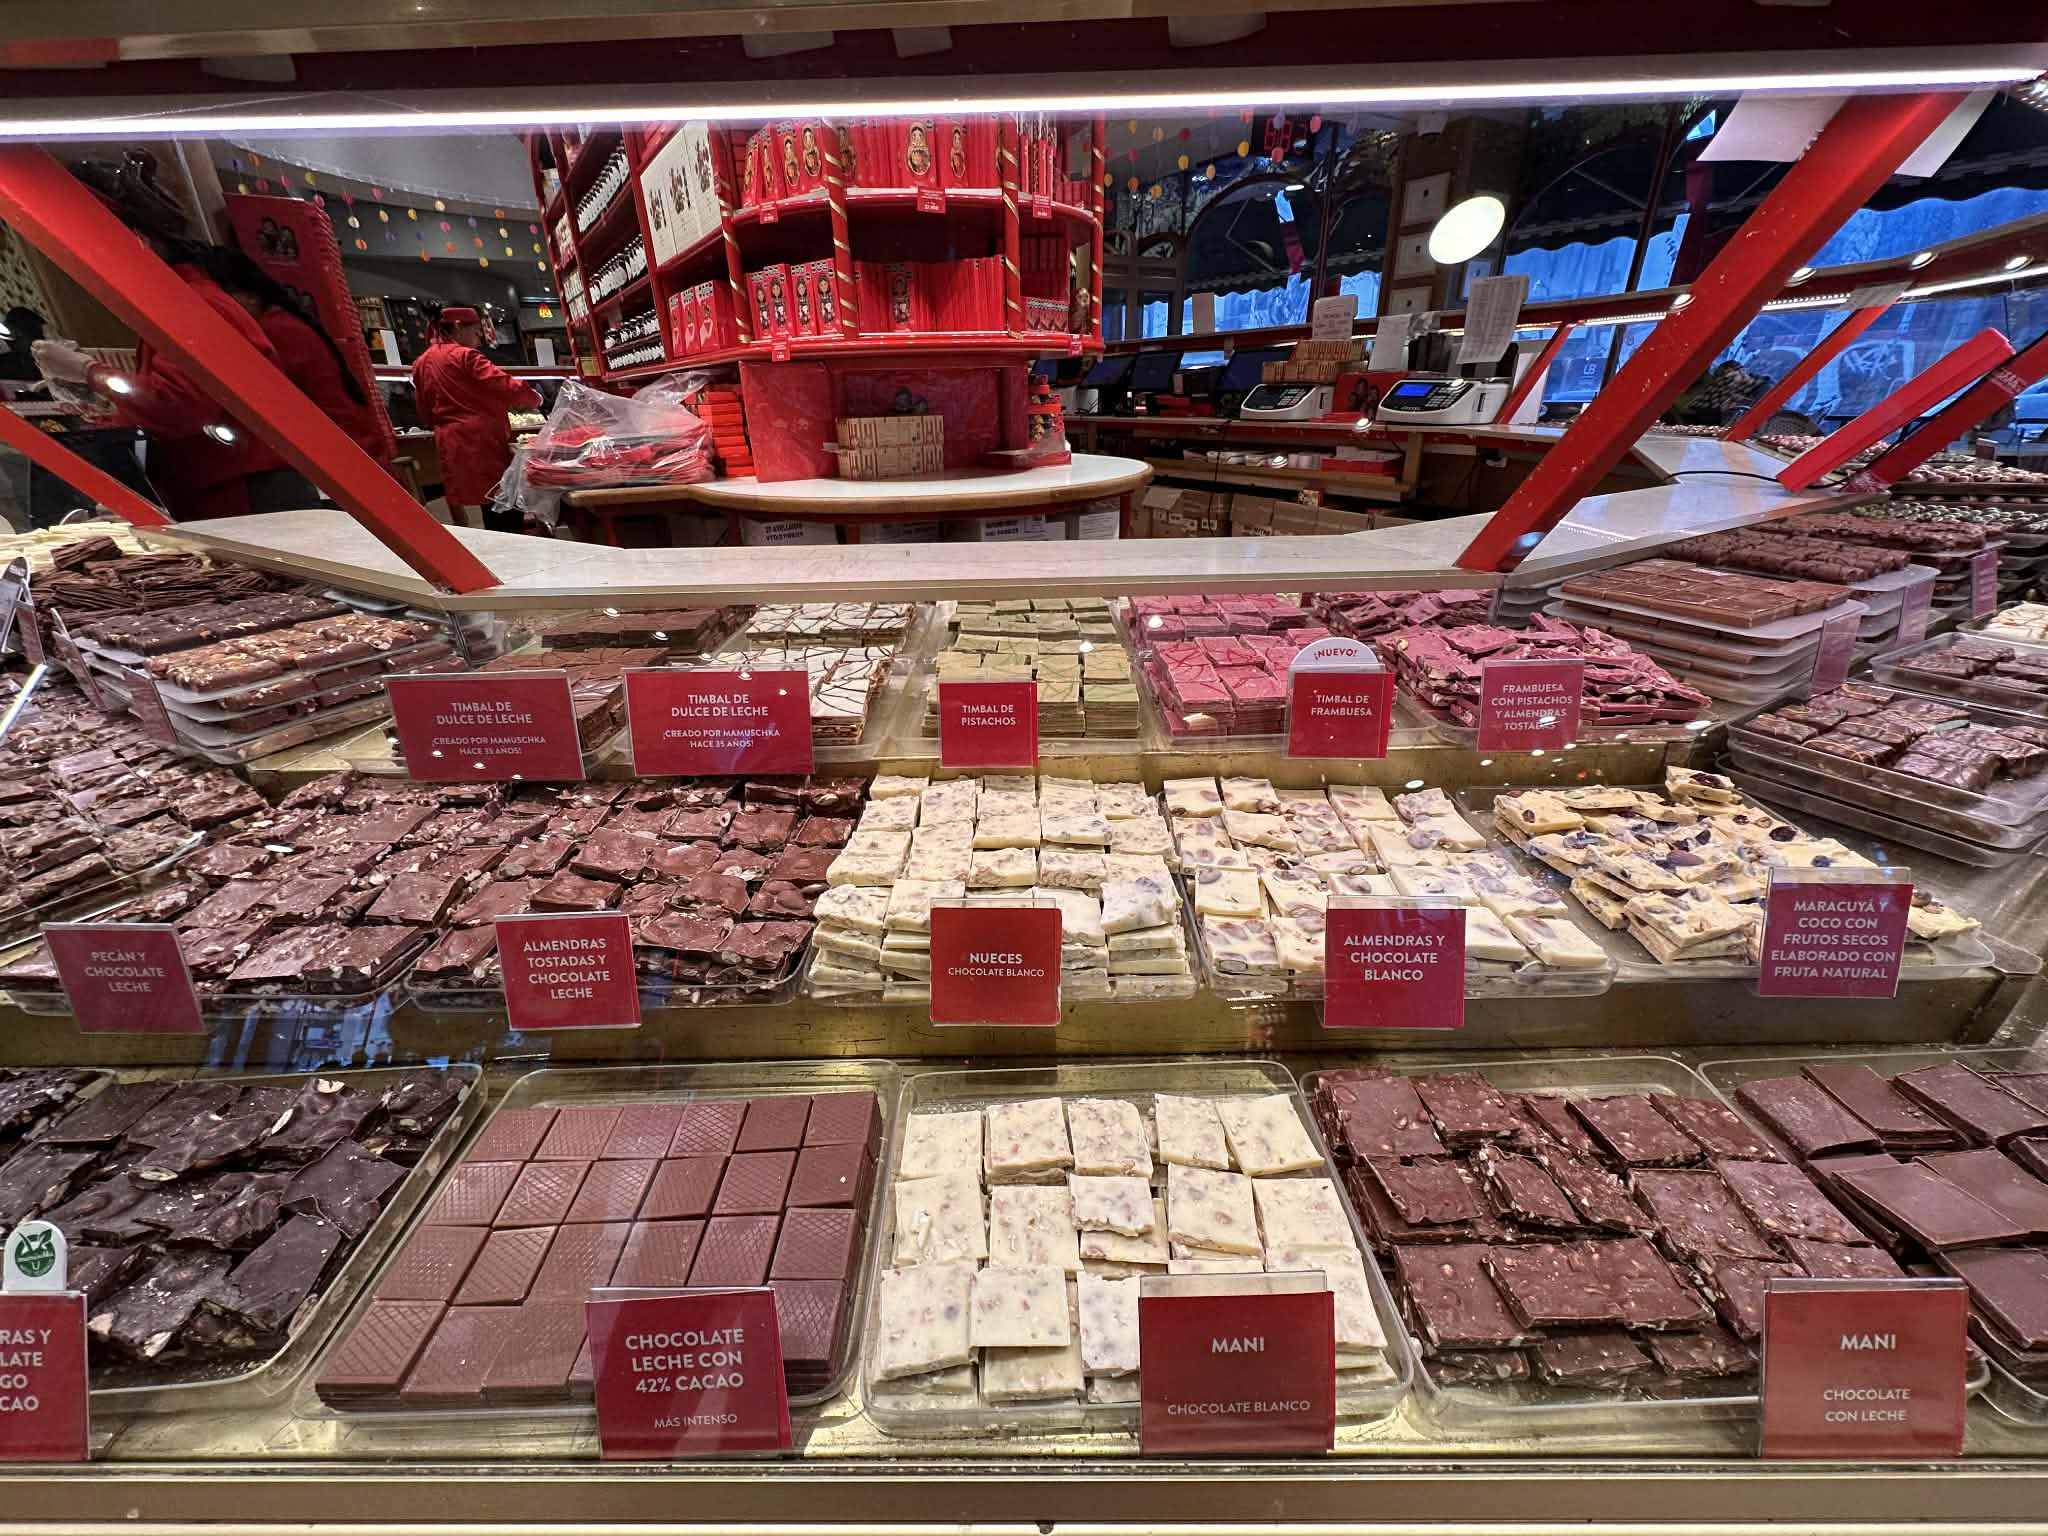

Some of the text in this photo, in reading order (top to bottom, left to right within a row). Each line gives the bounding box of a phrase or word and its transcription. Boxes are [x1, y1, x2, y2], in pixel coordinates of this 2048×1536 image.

[1313, 648, 1358, 661] ¡NUEVO!
[1502, 683, 1565, 693] FRAMBUESA
[687, 694, 750, 704] TIMBAL DE
[1316, 694, 1369, 704] TIMBAL DE
[1491, 695, 1574, 706] CON PISTACHOS
[450, 701, 513, 713] TIMBAL DE
[671, 706, 769, 717] DULCE DE LECHE
[961, 704, 1014, 714] TIMBAL DE
[1311, 707, 1372, 716] FRAMBUESA
[1495, 708, 1567, 718] Y ALMENDRAS
[436, 713, 533, 725] DULCE DE LECHE
[961, 716, 1017, 726] PISTACHOS
[1504, 721, 1556, 730] TOSTADS
[703, 729, 721, 737] POR
[723, 729, 781, 737] MAMUSCHKA
[471, 737, 489, 745] POR
[490, 735, 546, 745] MAMUSCHKA
[690, 740, 713, 748] HACE
[715, 740, 725, 748] 35
[459, 747, 482, 755] HACE
[1793, 899, 1889, 913] MARACUYÁ Y
[1798, 917, 1878, 929] COCO CON
[523, 938, 607, 953] ALMENDRAS
[1344, 935, 1446, 946] ALMENDRAS Y
[1783, 933, 1889, 946] FRUTOS SECOS
[138, 951, 146, 961] Y
[527, 954, 606, 969] TOSTADAS Y
[969, 952, 1024, 965] NUECES
[1350, 952, 1438, 964] CHOCOLATE
[1771, 950, 1896, 962] ELABORADO CON
[84, 967, 166, 977] CHOCOLATE
[528, 970, 611, 984] CHOCOLATE
[948, 967, 1045, 977] CHOCOLATE BLANCO
[1364, 969, 1424, 981] BLANCO
[1774, 966, 1888, 979] FRUTA NATURAL
[107, 981, 152, 993] LECHE
[550, 987, 593, 1000] LECHE
[0, 1329, 52, 1345] RAS Y
[625, 1328, 745, 1350] CHOCOLATE
[1840, 1333, 1897, 1350] MANI
[1211, 1336, 1265, 1353] MANI
[0, 1351, 43, 1367] LATE
[631, 1350, 743, 1372] LECHE CON
[0, 1374, 28, 1389] GO
[635, 1372, 744, 1393] 42% CACAO
[1823, 1388, 1912, 1401] CHOCOLATE
[0, 1395, 39, 1412] CAO
[1167, 1400, 1311, 1416] CHOCOLATE BLANCO
[684, 1413, 738, 1427] INTENSO
[1824, 1409, 1907, 1422] CON LECHE
